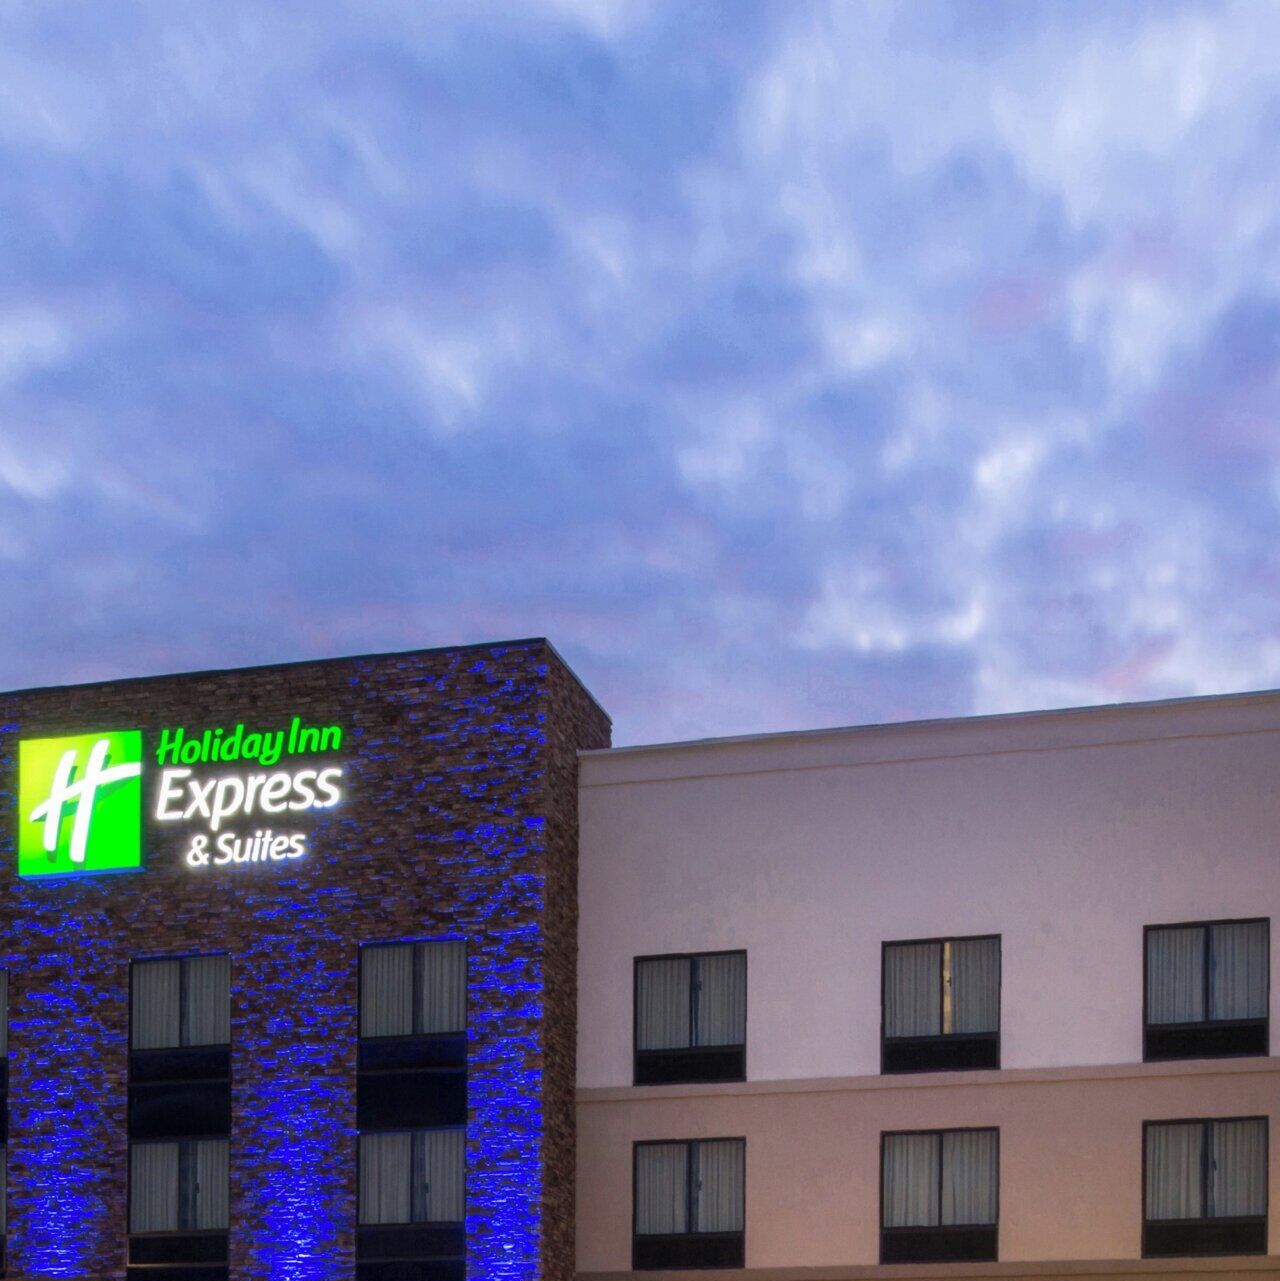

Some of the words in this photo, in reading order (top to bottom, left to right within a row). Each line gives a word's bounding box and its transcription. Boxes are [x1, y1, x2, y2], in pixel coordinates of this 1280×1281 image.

[156, 723, 284, 766] Holiday
[287, 717, 342, 754] Inn
[155, 767, 343, 831] Express
[186, 835, 209, 867] &
[214, 830, 306, 865] Suites
